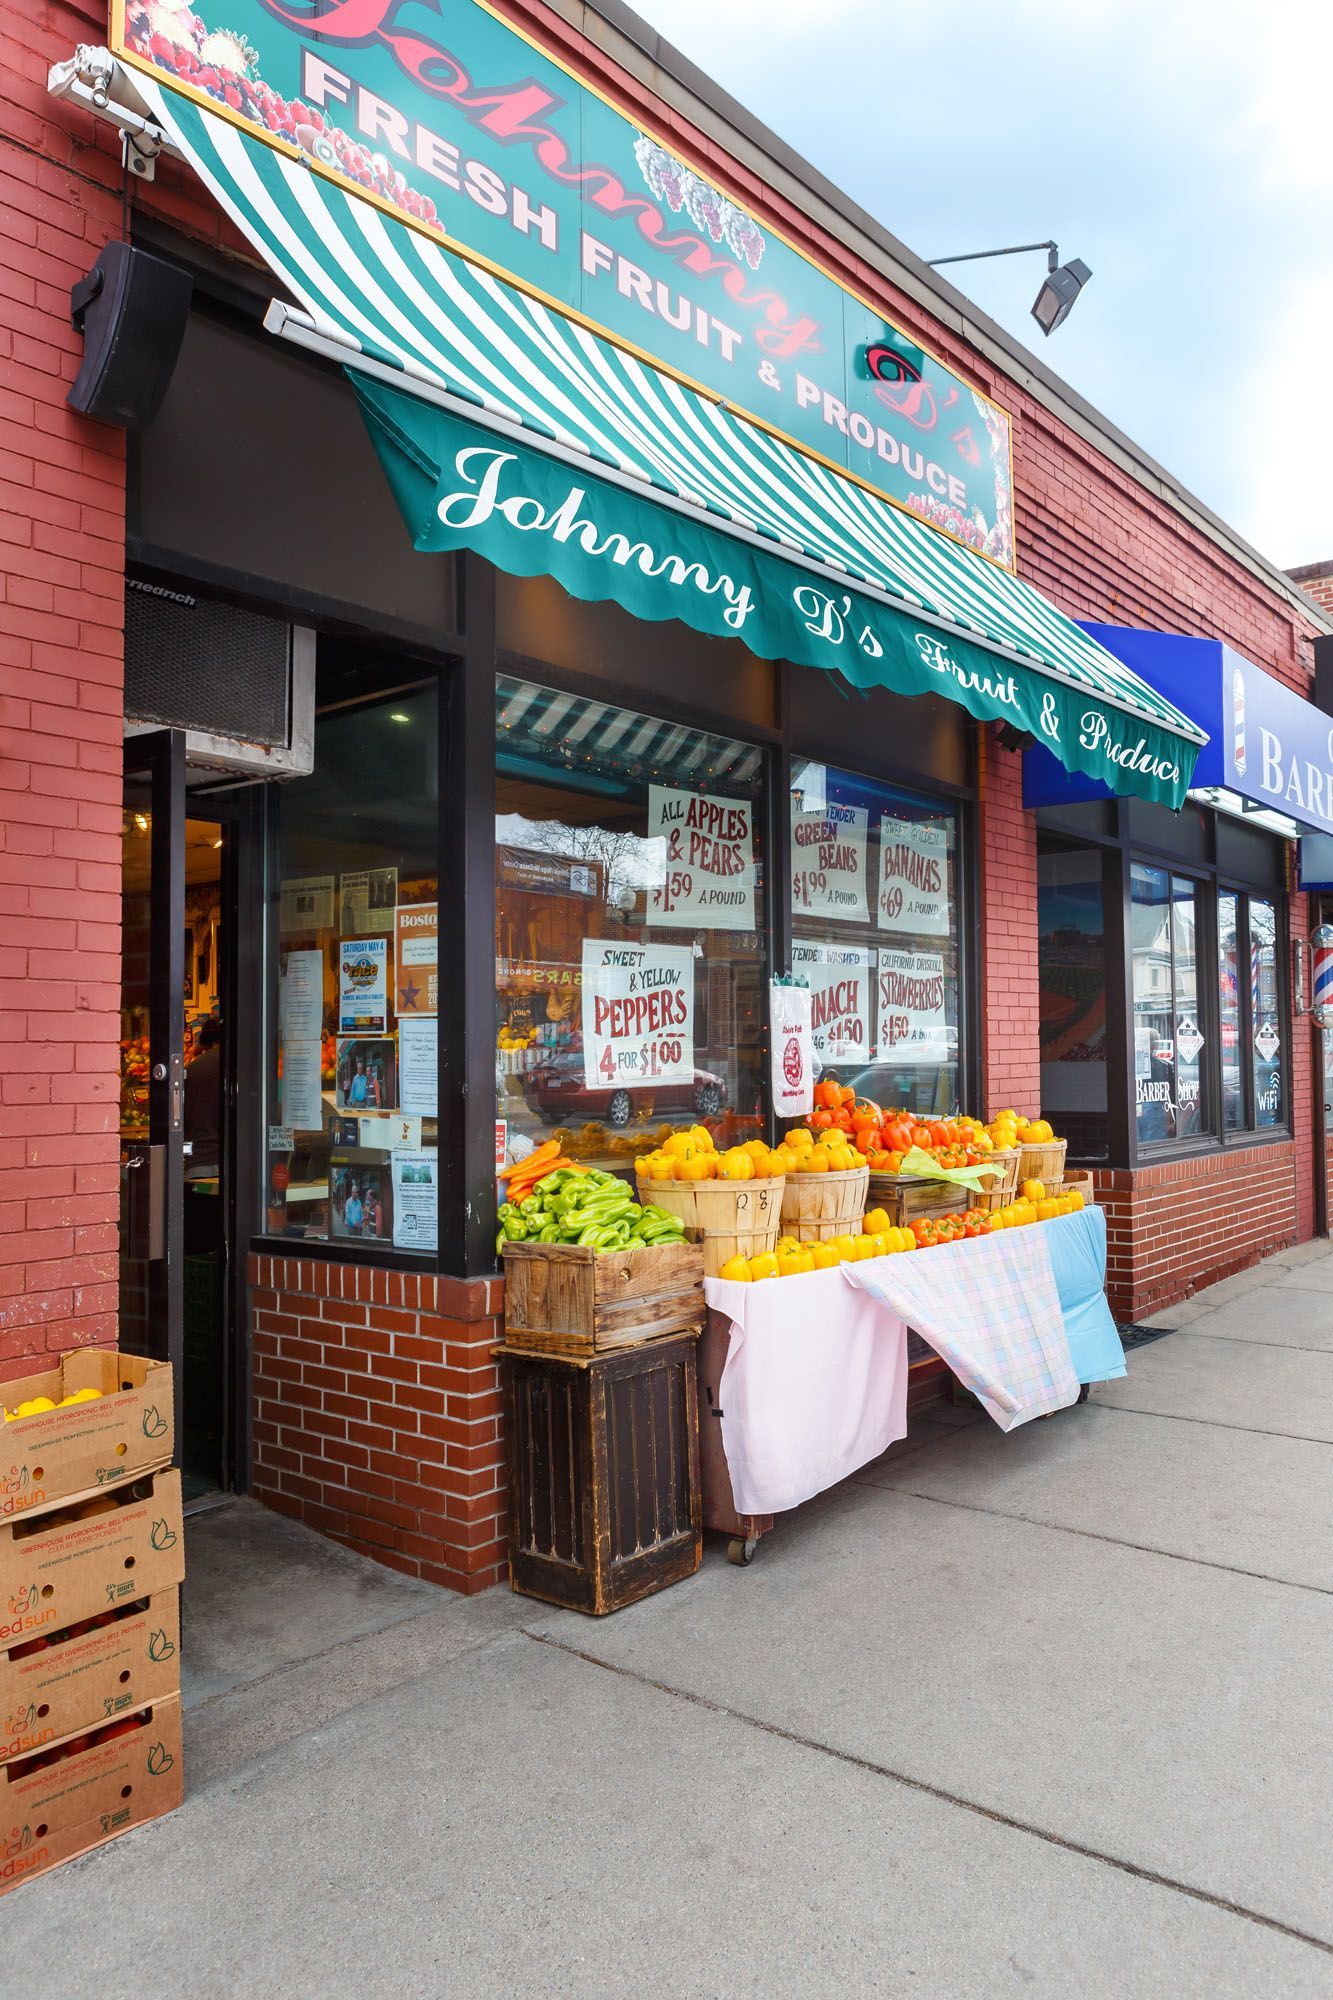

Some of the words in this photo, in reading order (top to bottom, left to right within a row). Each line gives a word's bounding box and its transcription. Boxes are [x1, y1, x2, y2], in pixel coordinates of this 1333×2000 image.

[303, 50, 557, 251] FRESH
[581, 232, 742, 363] FRUIT
[757, 359, 783, 392] &
[796, 374, 968, 510] PRODUCE
[866, 343, 981, 468] D's
[125, 578, 196, 606] riedrich
[437, 446, 755, 629] Johnny
[792, 585, 884, 658] D's
[915, 632, 1021, 710] Fruit
[1040, 692, 1061, 742] &
[1078, 711, 1180, 784] Produce
[660, 800, 685, 825] ALL
[684, 797, 748, 841] APPLES
[826, 806, 855, 824] TENDER
[795, 821, 838, 847] GREEN
[885, 821, 907, 839] SWEET
[667, 828, 685, 862] &
[689, 832, 745, 876] PEARS
[819, 844, 858, 873] BEANS
[884, 843, 942, 894] BANANAS
[698, 890, 707, 904] A
[709, 890, 746, 905] POUND
[827, 890, 834, 903] A
[835, 890, 857, 906] POUND
[907, 901, 914, 913] A
[915, 902, 939, 915] POUND
[343, 943, 367, 953] SATURDAY
[368, 942, 379, 952] MAY
[380, 941, 384, 950] 4
[601, 950, 646, 967] SWEET
[792, 946, 823, 962] TENDER
[826, 953, 861, 965] WASHED
[881, 954, 914, 970] CALIFORNIA
[629, 973, 639, 992] &
[638, 968, 681, 989] YELLOW
[880, 971, 944, 1014] STRAWBERRIES
[594, 989, 687, 1038] PEPPERS
[812, 1036, 825, 1050] AG
[911, 1029, 917, 1040] A
[599, 1045, 617, 1081] 4
[618, 1051, 637, 1069] FOR
[1135, 1078, 1170, 1103] BARBER
[1177, 1076, 1200, 1101] SHOP
[12, 1418, 56, 1435] GREENHOUSE
[56, 1406, 98, 1423] HYDROPONIC
[100, 1402, 113, 1412] BELL
[114, 1396, 139, 1408] PEPPERS
[0, 1489, 46, 1514] dsun
[21, 1536, 64, 1555] GREENHOUSE
[65, 1524, 106, 1541] HYDROPONIC
[108, 1519, 121, 1528] BELL
[122, 1510, 148, 1523] PEPPERS
[0, 1847, 49, 1878] dsun
